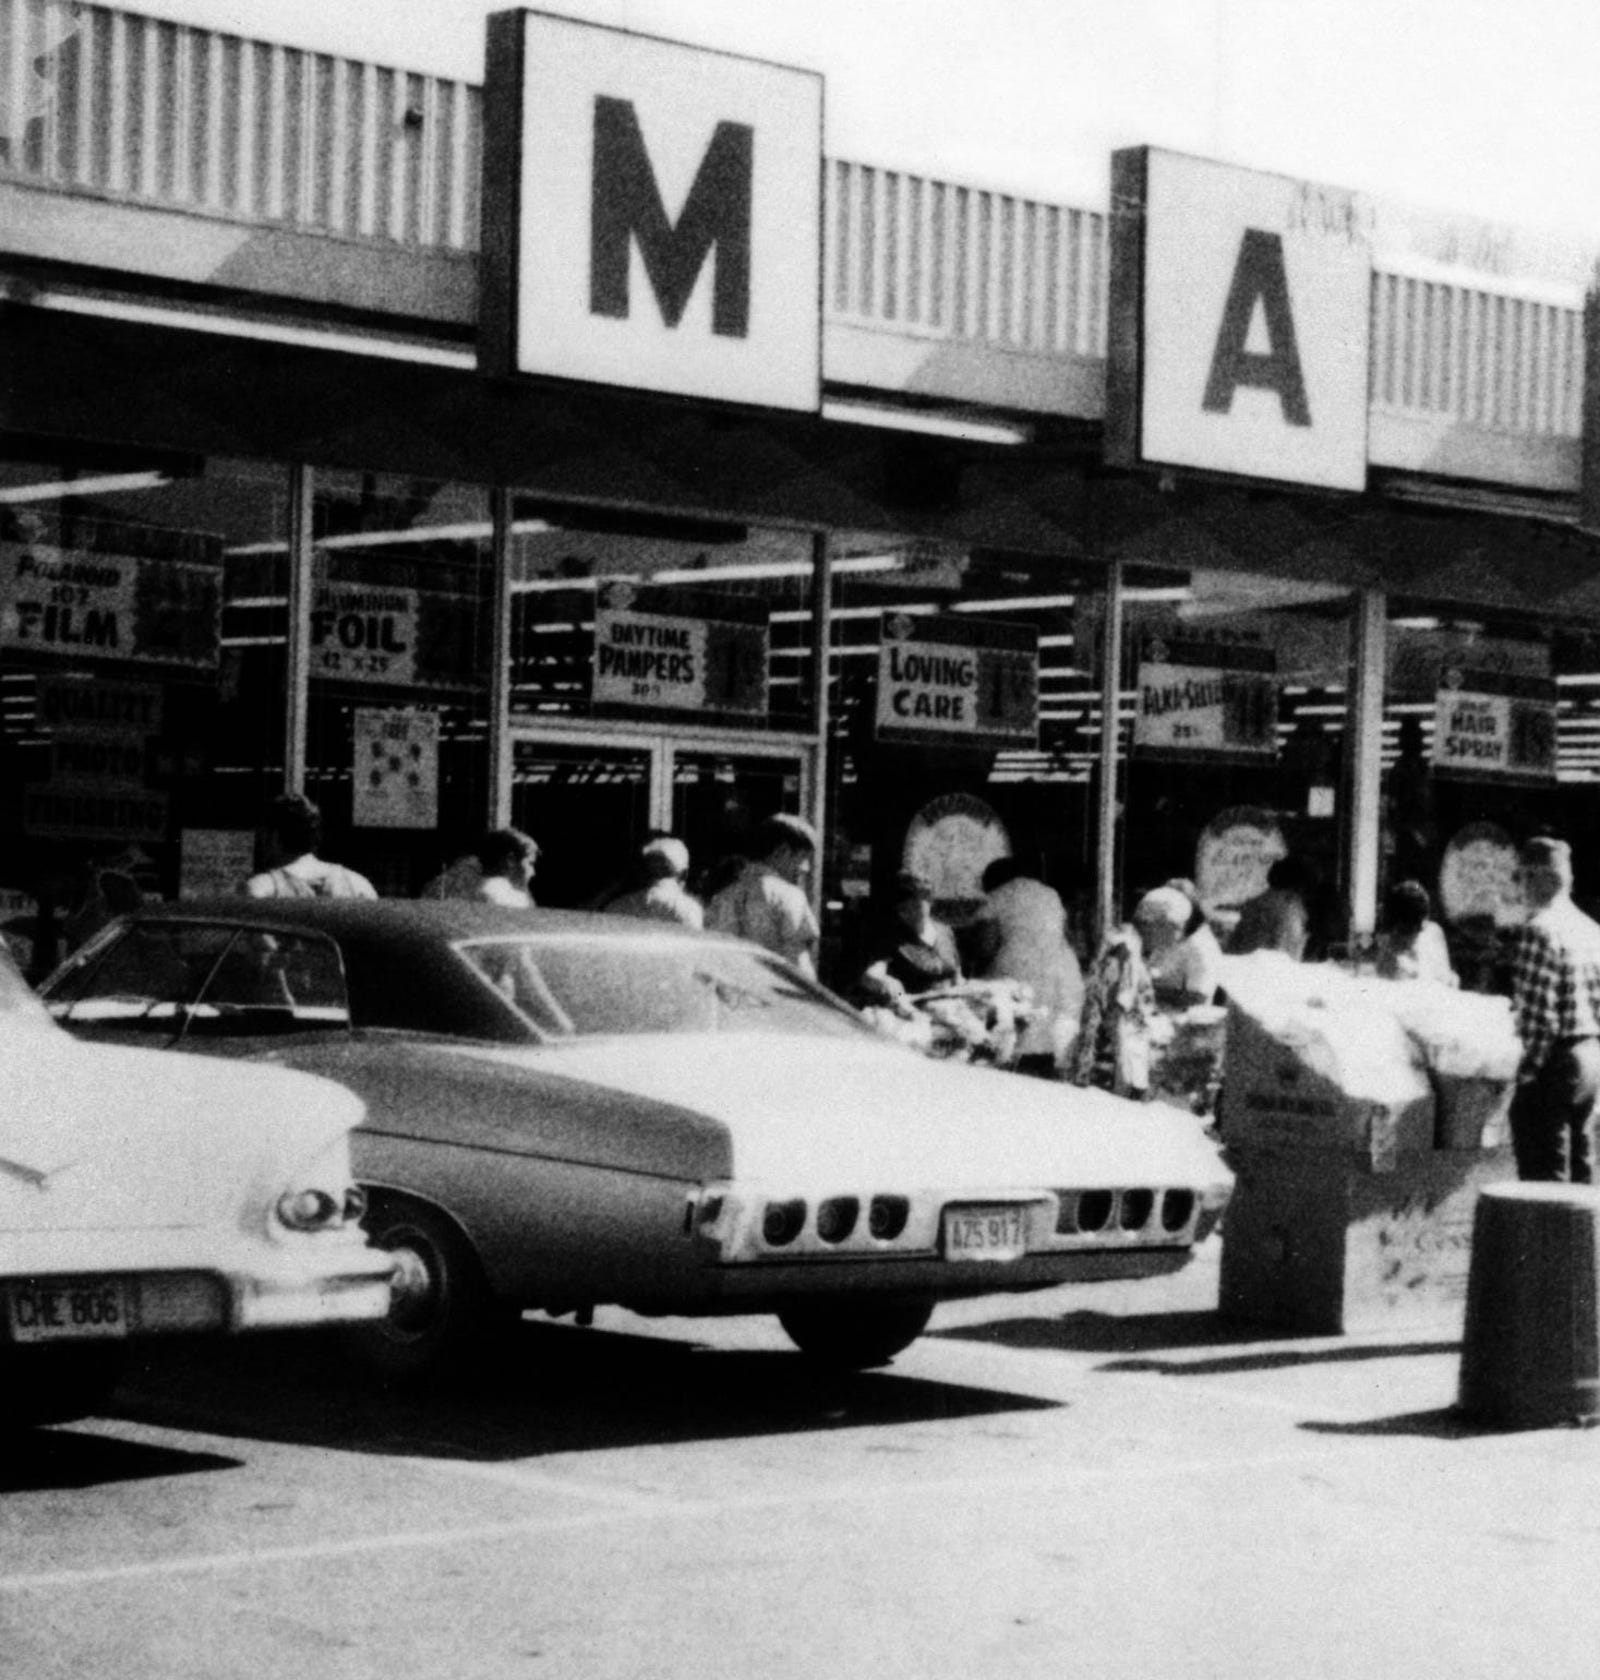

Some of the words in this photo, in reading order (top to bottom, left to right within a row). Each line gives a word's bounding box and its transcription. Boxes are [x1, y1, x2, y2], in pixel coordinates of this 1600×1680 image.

[16, 602, 117, 648] FILM
[311, 611, 406, 652] FOIL
[612, 624, 690, 649] DAYTIME
[600, 646, 694, 683] PAMPERS
[890, 647, 973, 687] LOVING
[893, 689, 964, 720] CARE
[1451, 713, 1496, 735] HAIR
[1446, 737, 1501, 760] SPRAY
[988, 1207, 1021, 1247] 917
[17, 1292, 64, 1327] CHE
[71, 1288, 118, 1325] 806
